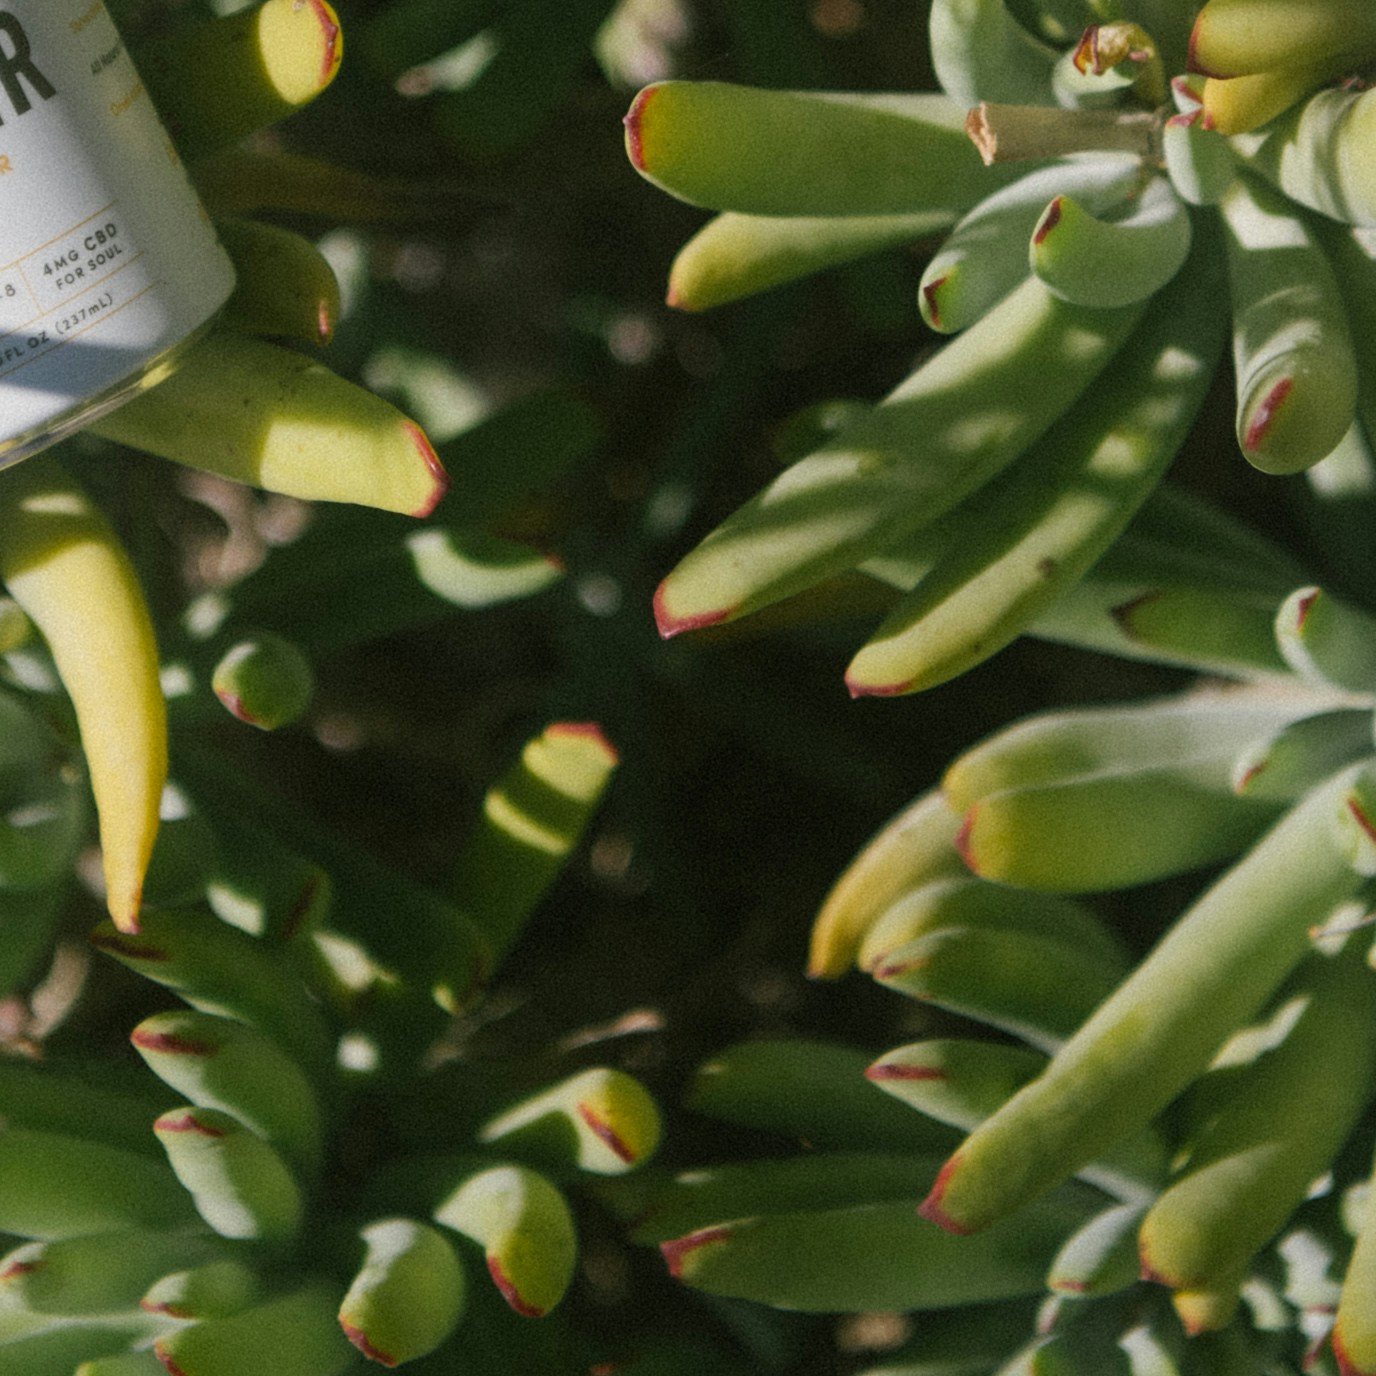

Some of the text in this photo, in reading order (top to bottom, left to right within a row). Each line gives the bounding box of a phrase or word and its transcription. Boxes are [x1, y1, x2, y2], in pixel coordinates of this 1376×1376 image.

[43, 222, 118, 277] 4MG CBD
[56, 243, 122, 290] FOR SOUL
[27, 331, 50, 349] OZ
[55, 293, 114, 335] (237mL)
